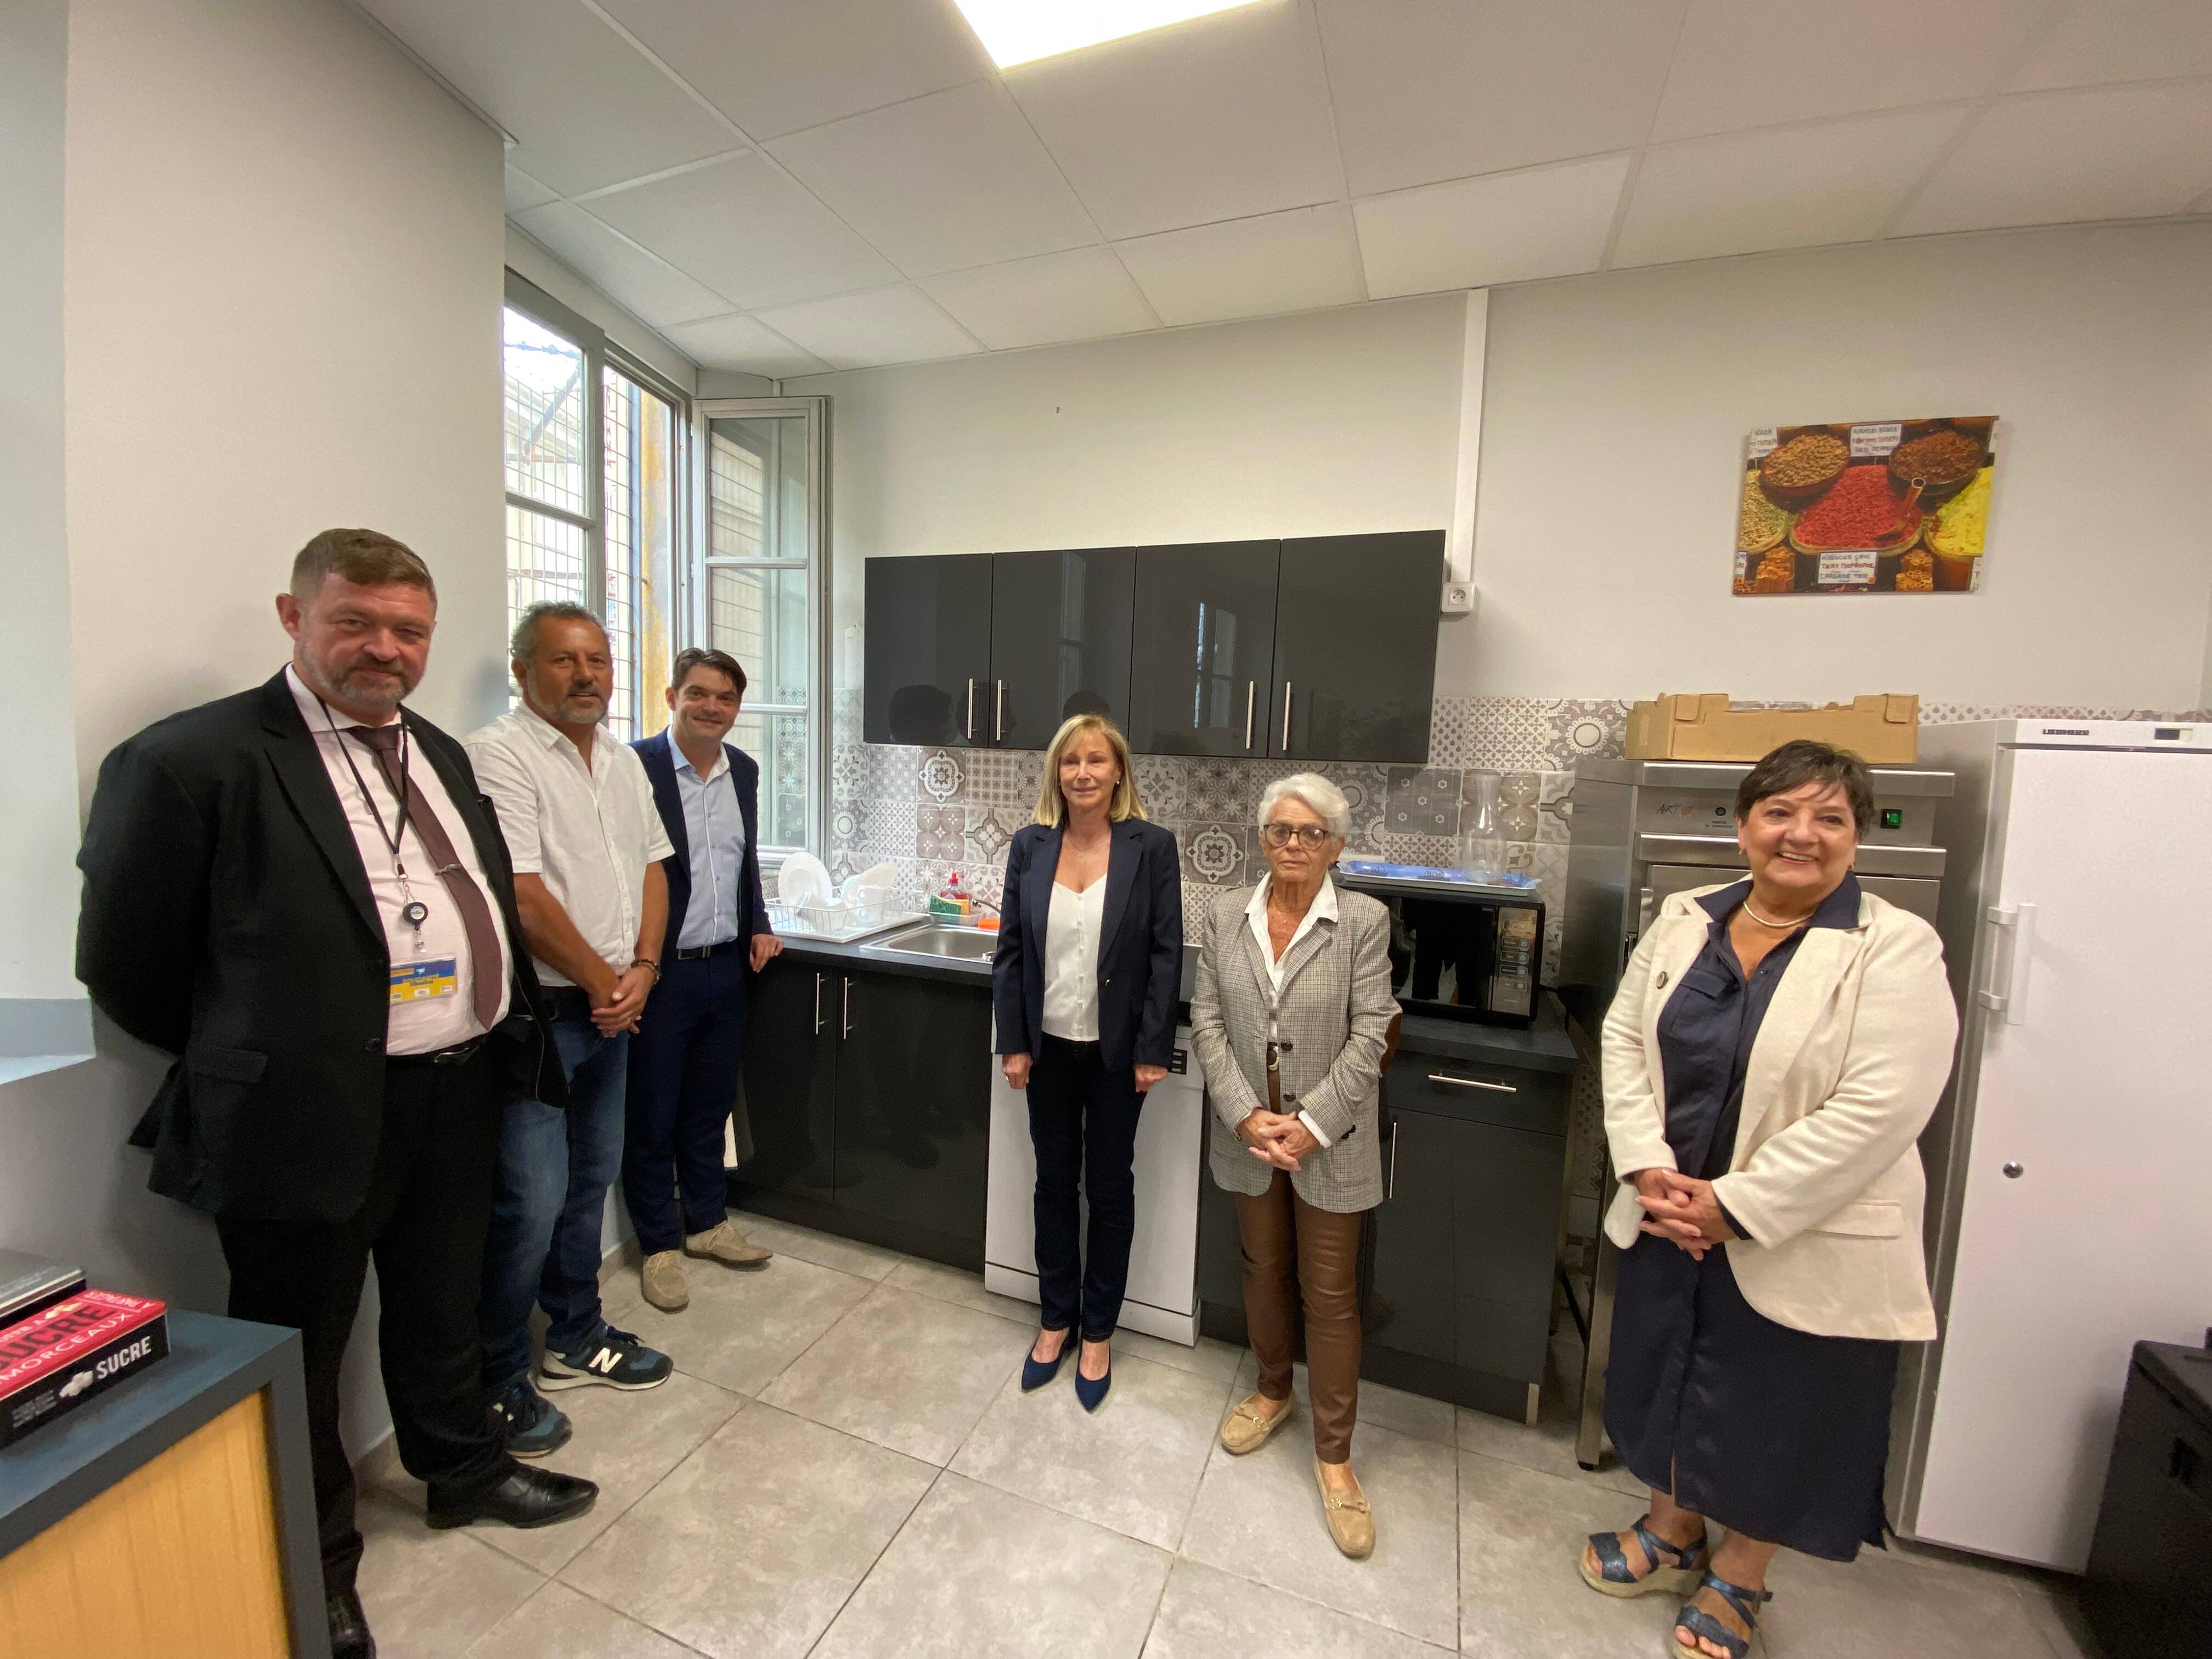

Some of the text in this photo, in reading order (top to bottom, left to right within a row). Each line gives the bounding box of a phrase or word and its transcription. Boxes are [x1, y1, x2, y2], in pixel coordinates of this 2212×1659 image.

[0, 1306, 117, 1370] UCRE
[0, 1313, 134, 1381] MORCEAUX
[96, 1335, 152, 1380] SUCRE
[588, 1347, 623, 1373] N
